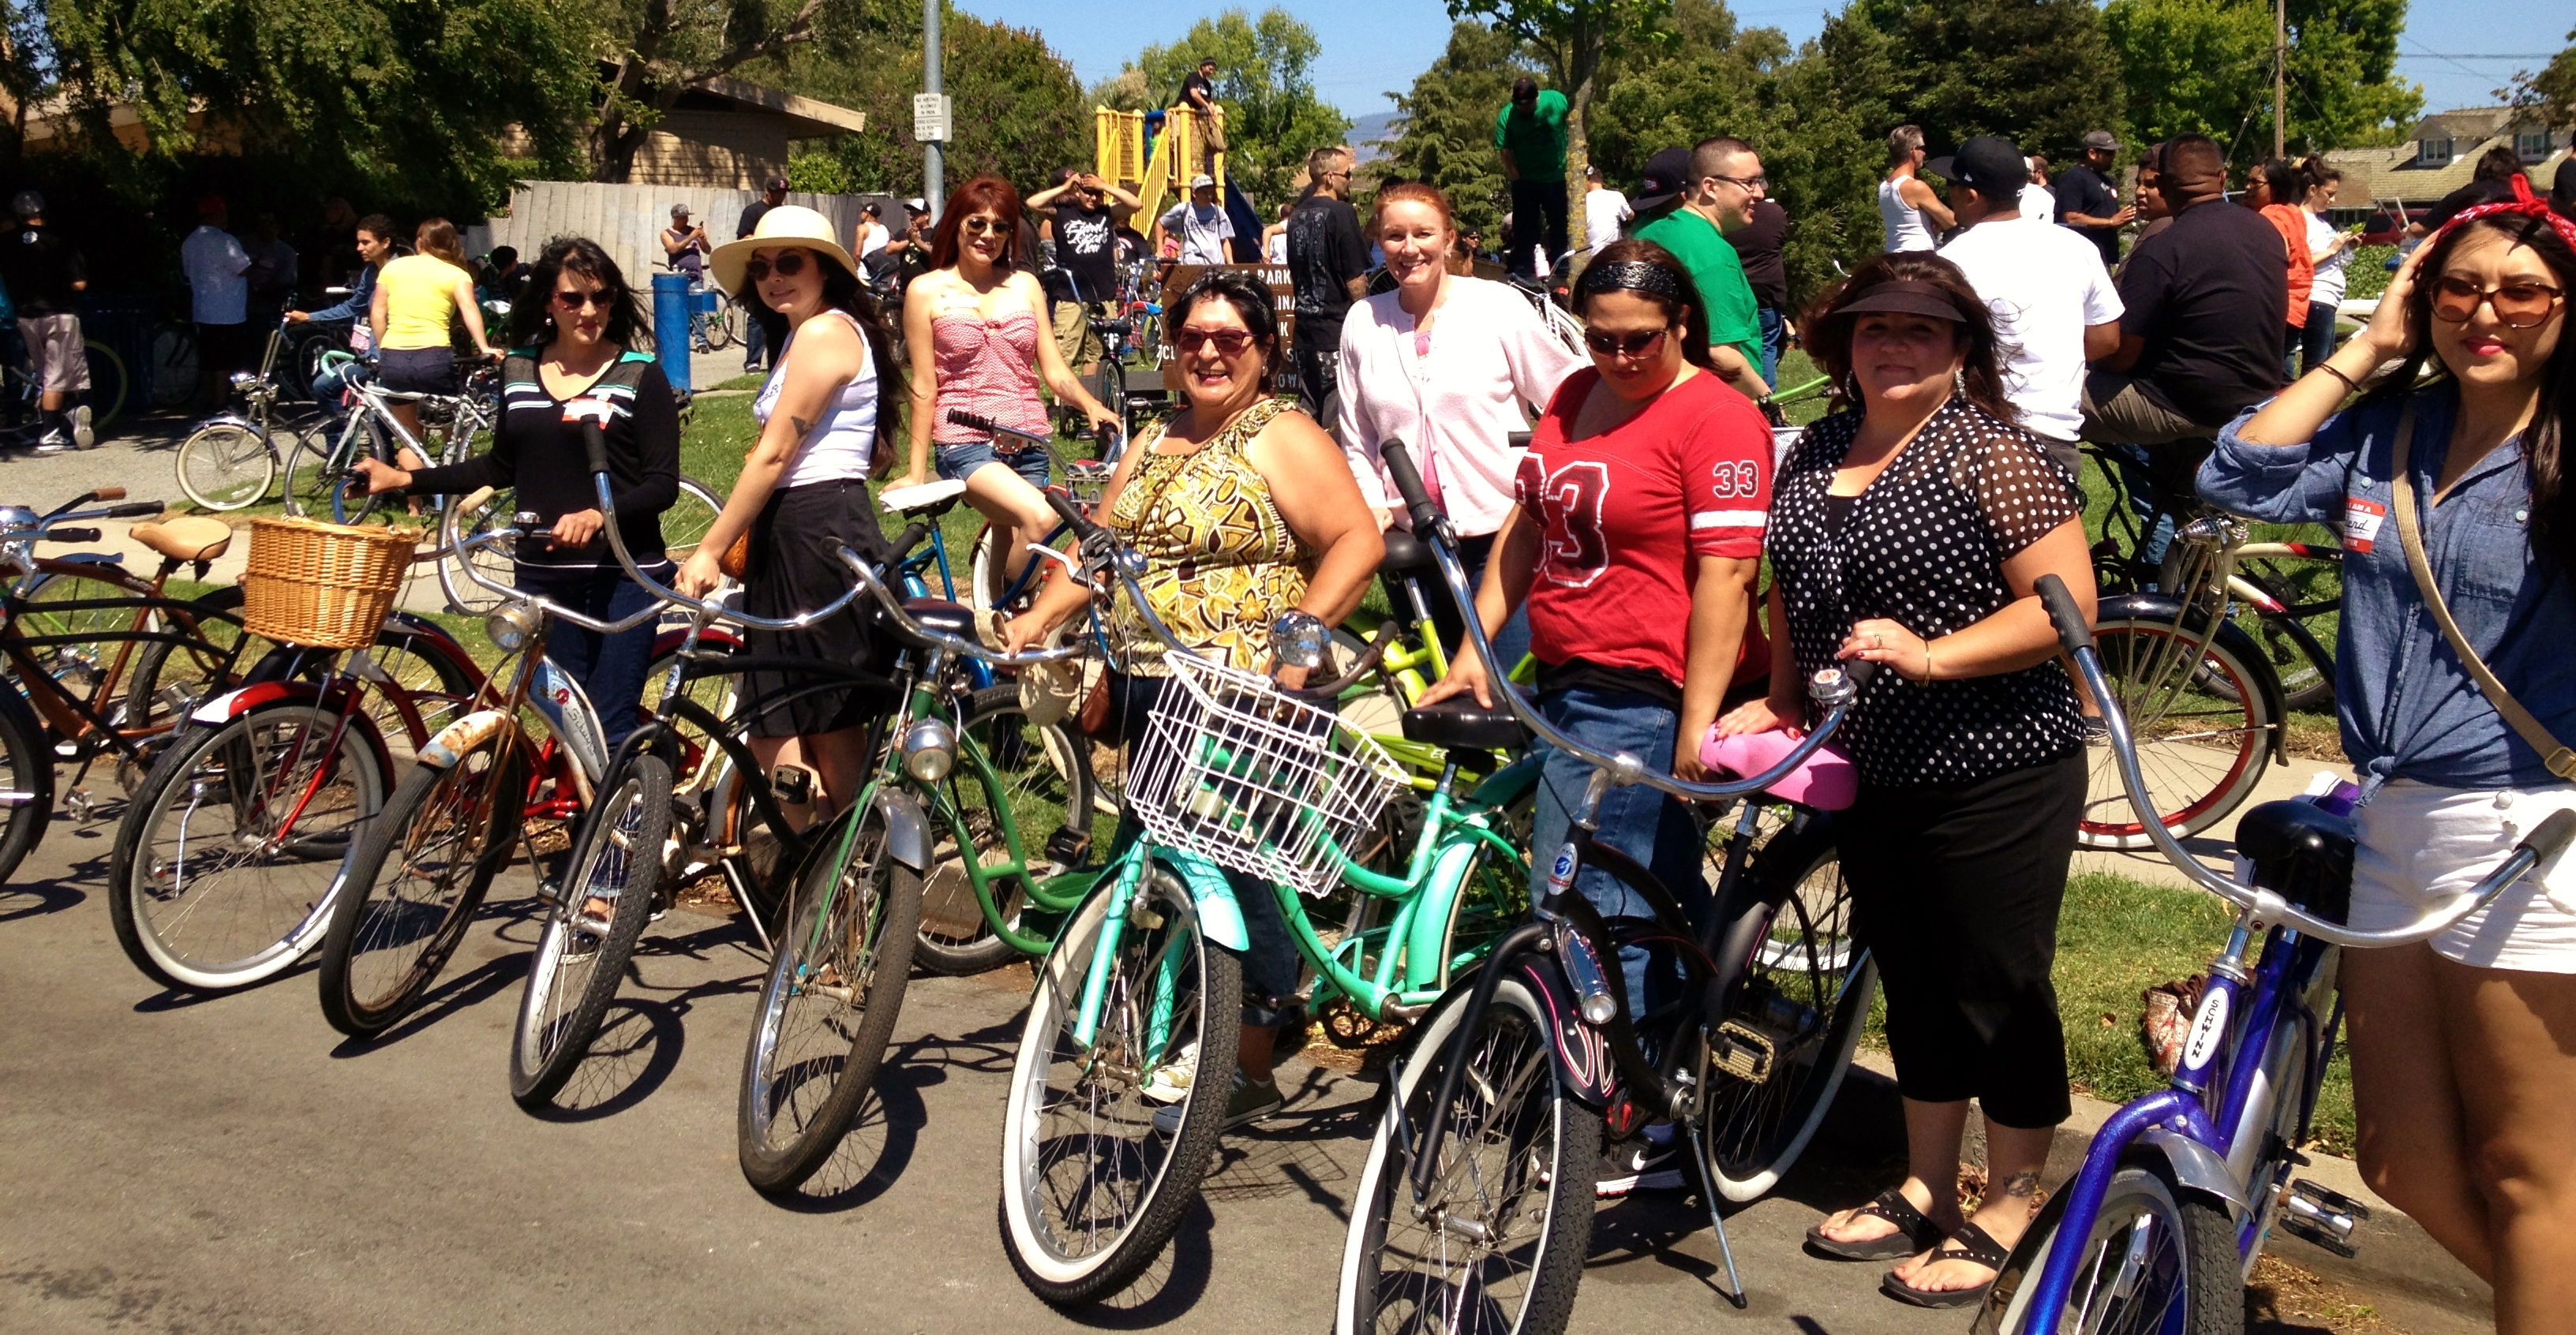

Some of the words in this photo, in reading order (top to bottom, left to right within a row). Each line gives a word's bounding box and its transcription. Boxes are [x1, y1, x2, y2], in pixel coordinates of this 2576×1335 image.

[1257, 269, 1292, 285] PARK
[1712, 459, 1759, 499] 33
[2192, 999, 2220, 1058] SCHWINN
